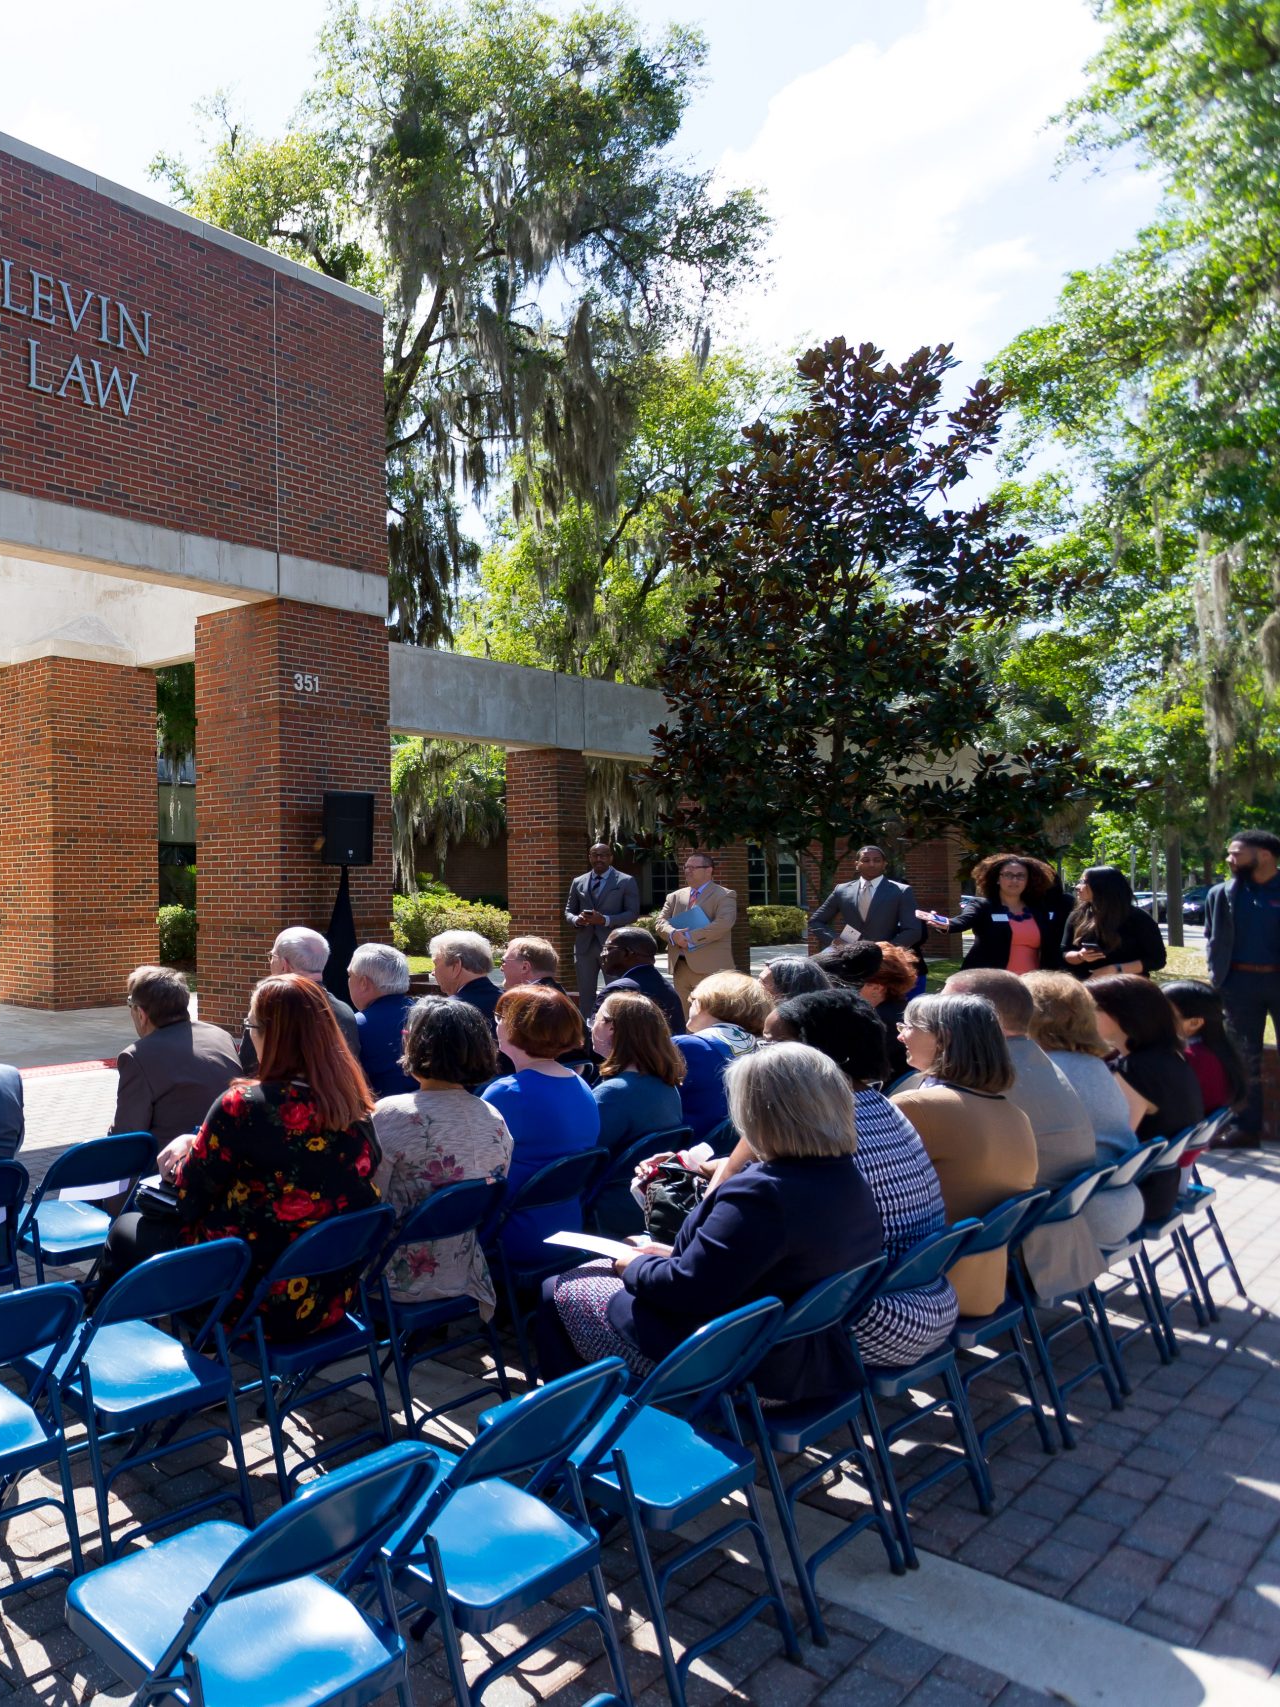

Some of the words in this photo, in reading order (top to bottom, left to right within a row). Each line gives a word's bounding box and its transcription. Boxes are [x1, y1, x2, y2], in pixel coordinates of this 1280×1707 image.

[0, 258, 152, 358] LEVIN
[27, 338, 140, 417] LAW
[294, 673, 319, 693] 351
